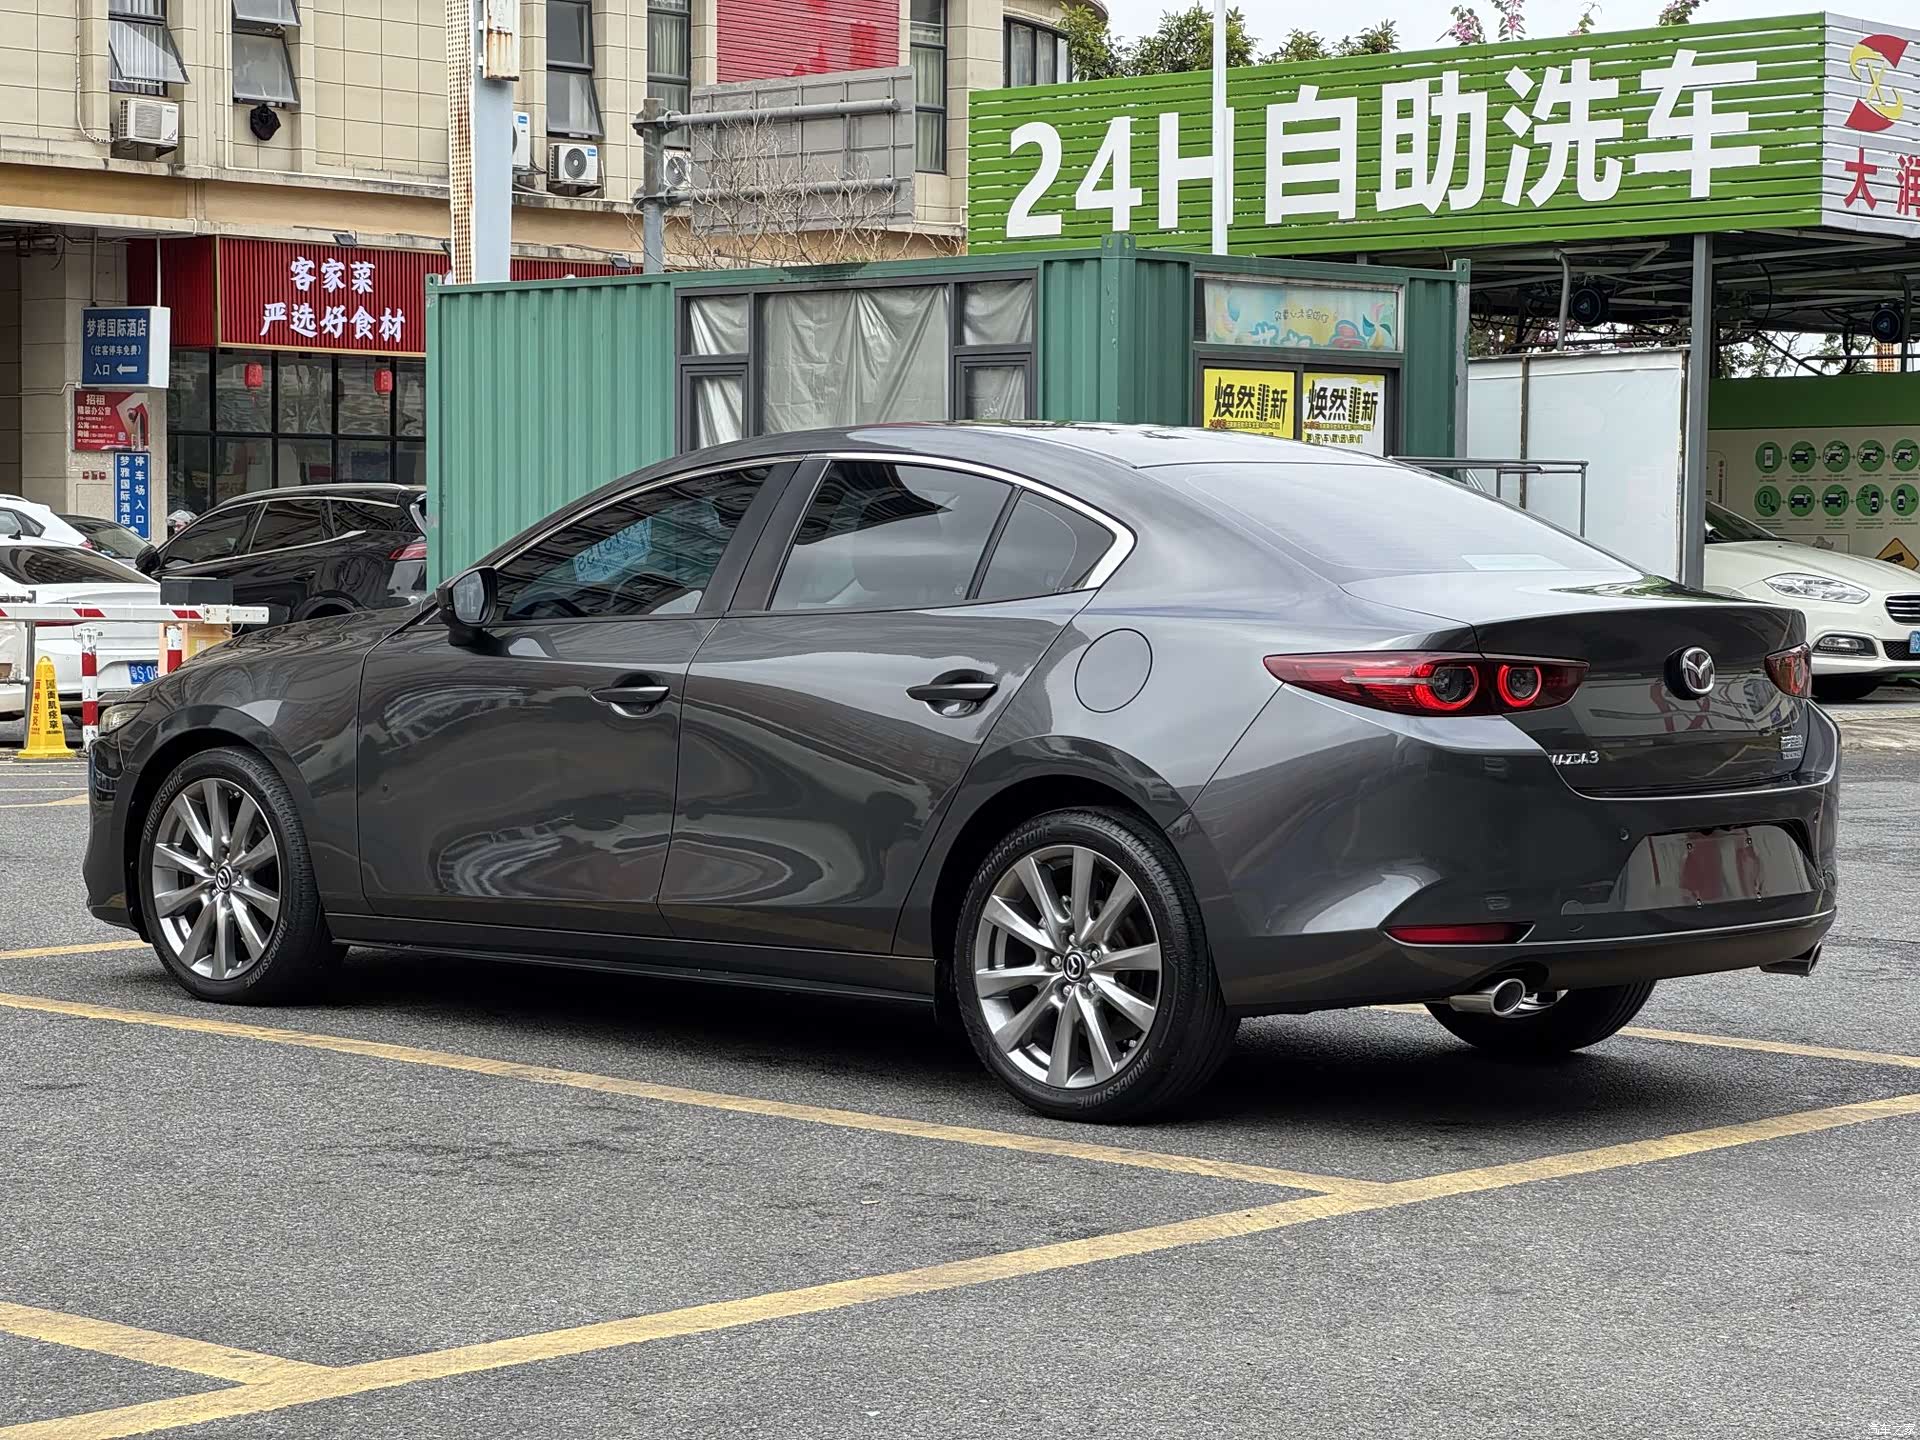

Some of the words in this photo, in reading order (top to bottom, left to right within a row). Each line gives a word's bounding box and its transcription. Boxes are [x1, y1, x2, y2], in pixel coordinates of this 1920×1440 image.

[1006, 49, 1762, 238] 24H自助洗车
[290, 256, 376, 295] 客家菜
[87, 317, 147, 338] 梦雅国际酒店
[259, 302, 406, 343] 严选好食材
[93, 363, 110, 376] 入口
[86, 394, 106, 405] 招租
[120, 456, 131, 525] 梦雅国际酒店
[134, 456, 146, 524] 停车场入口
[143, 772, 184, 843] BRIDGESTONE
[245, 916, 289, 988] BRIDGESTONE
